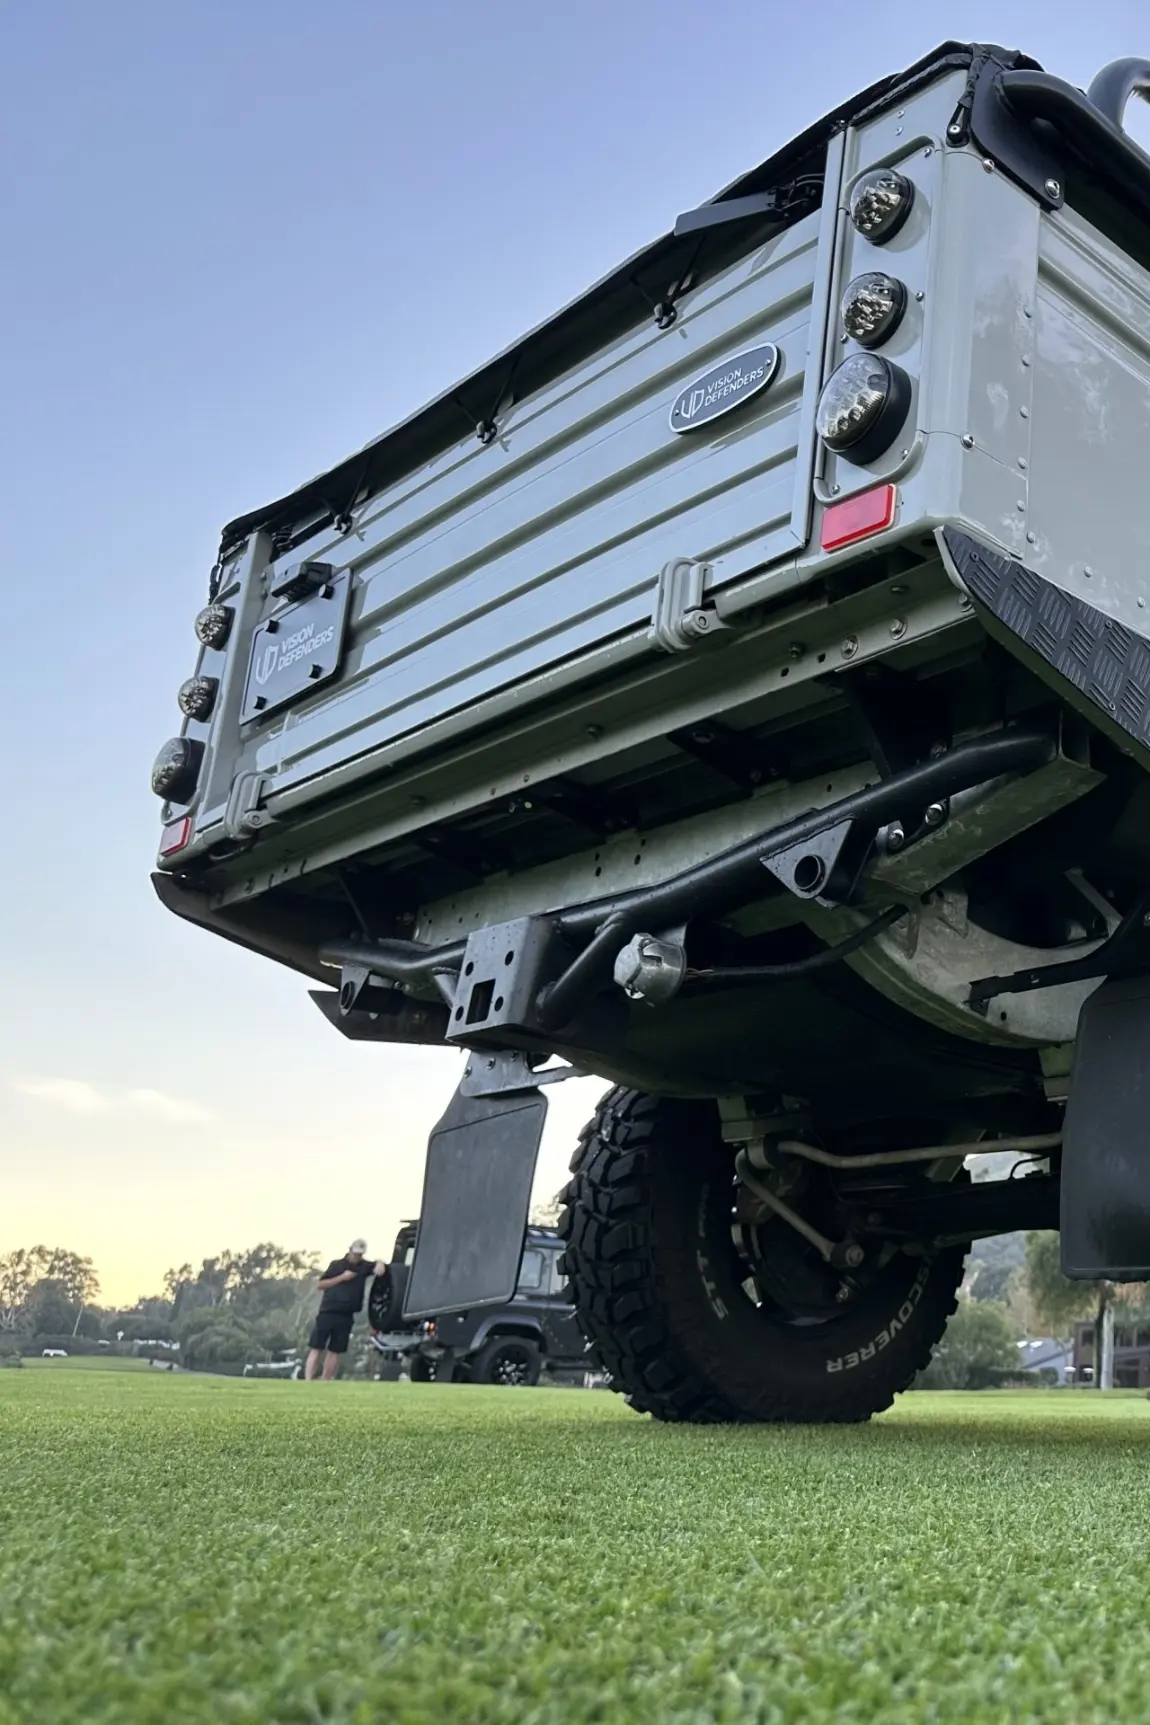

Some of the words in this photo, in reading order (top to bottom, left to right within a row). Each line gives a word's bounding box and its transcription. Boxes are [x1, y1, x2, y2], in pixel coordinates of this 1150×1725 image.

[704, 366, 765, 407] DEFENDERS
[707, 368, 742, 393] VISION
[277, 626, 335, 671] DEFENDERS
[281, 623, 315, 654] VISION
